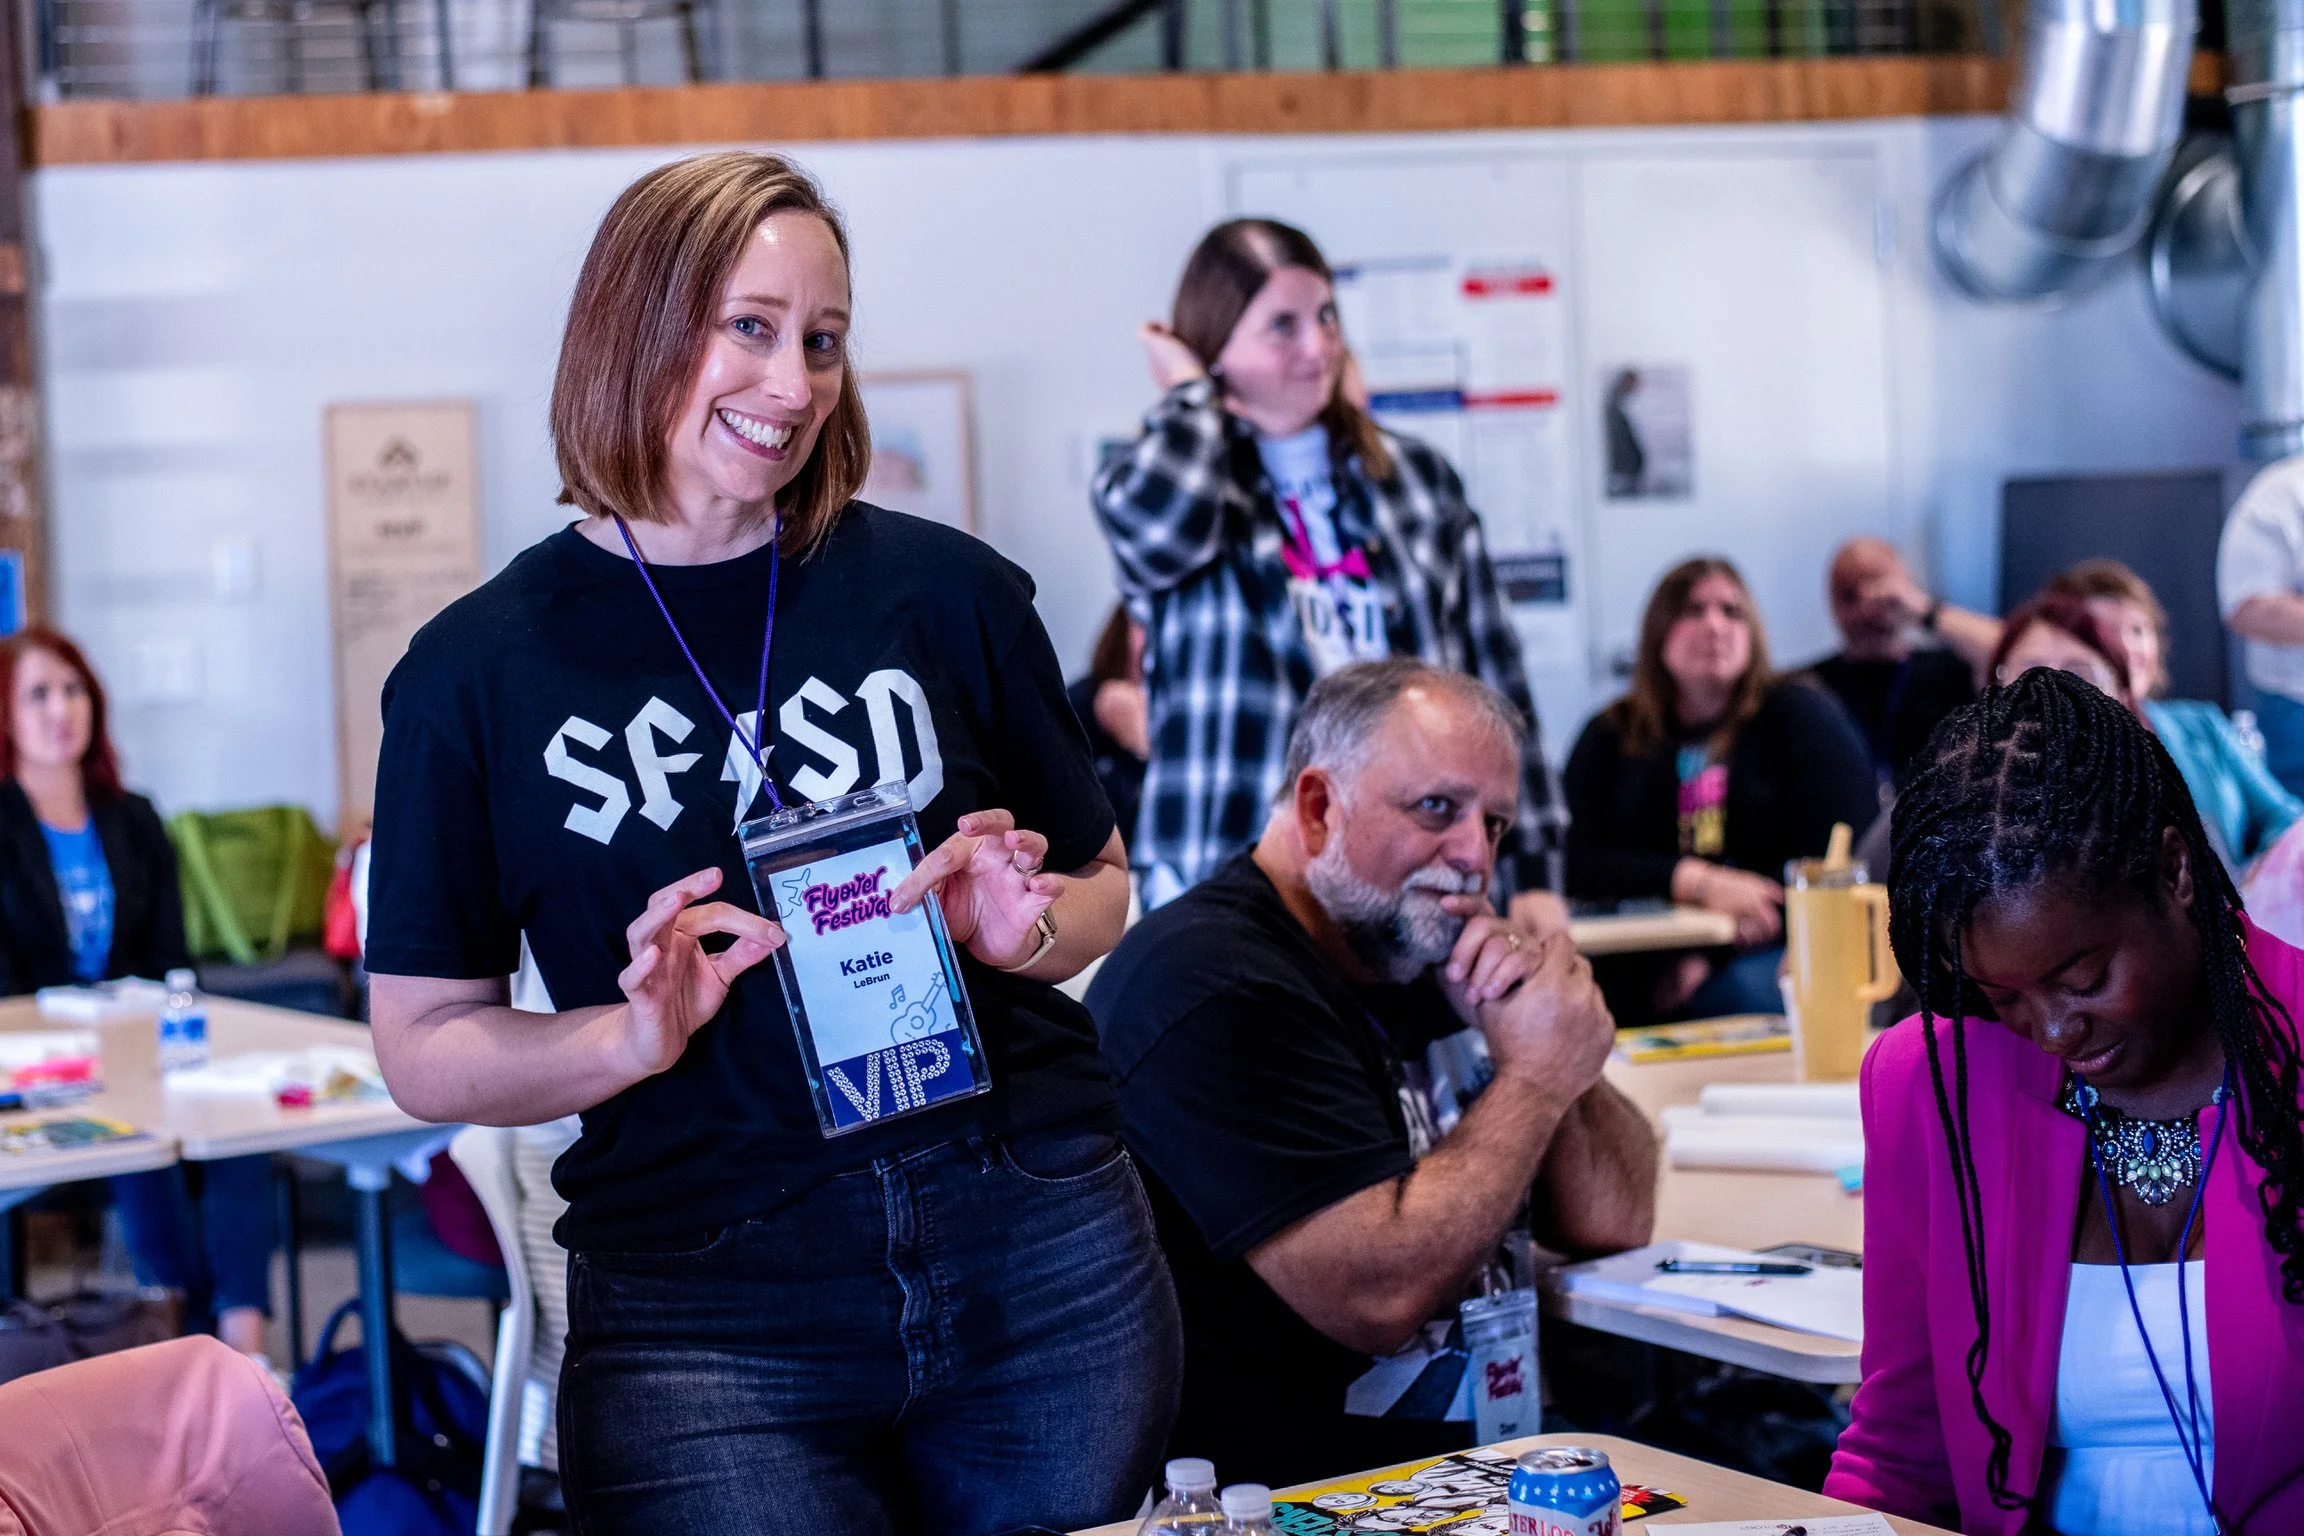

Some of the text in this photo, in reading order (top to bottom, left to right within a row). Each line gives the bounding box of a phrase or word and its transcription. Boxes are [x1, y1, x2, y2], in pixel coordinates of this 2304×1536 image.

[803, 865, 887, 912] Flyover
[811, 888, 893, 936] Festival
[840, 951, 893, 976] Katie
[853, 973, 890, 989] LeBrun
[827, 1038, 950, 1121] VIP
